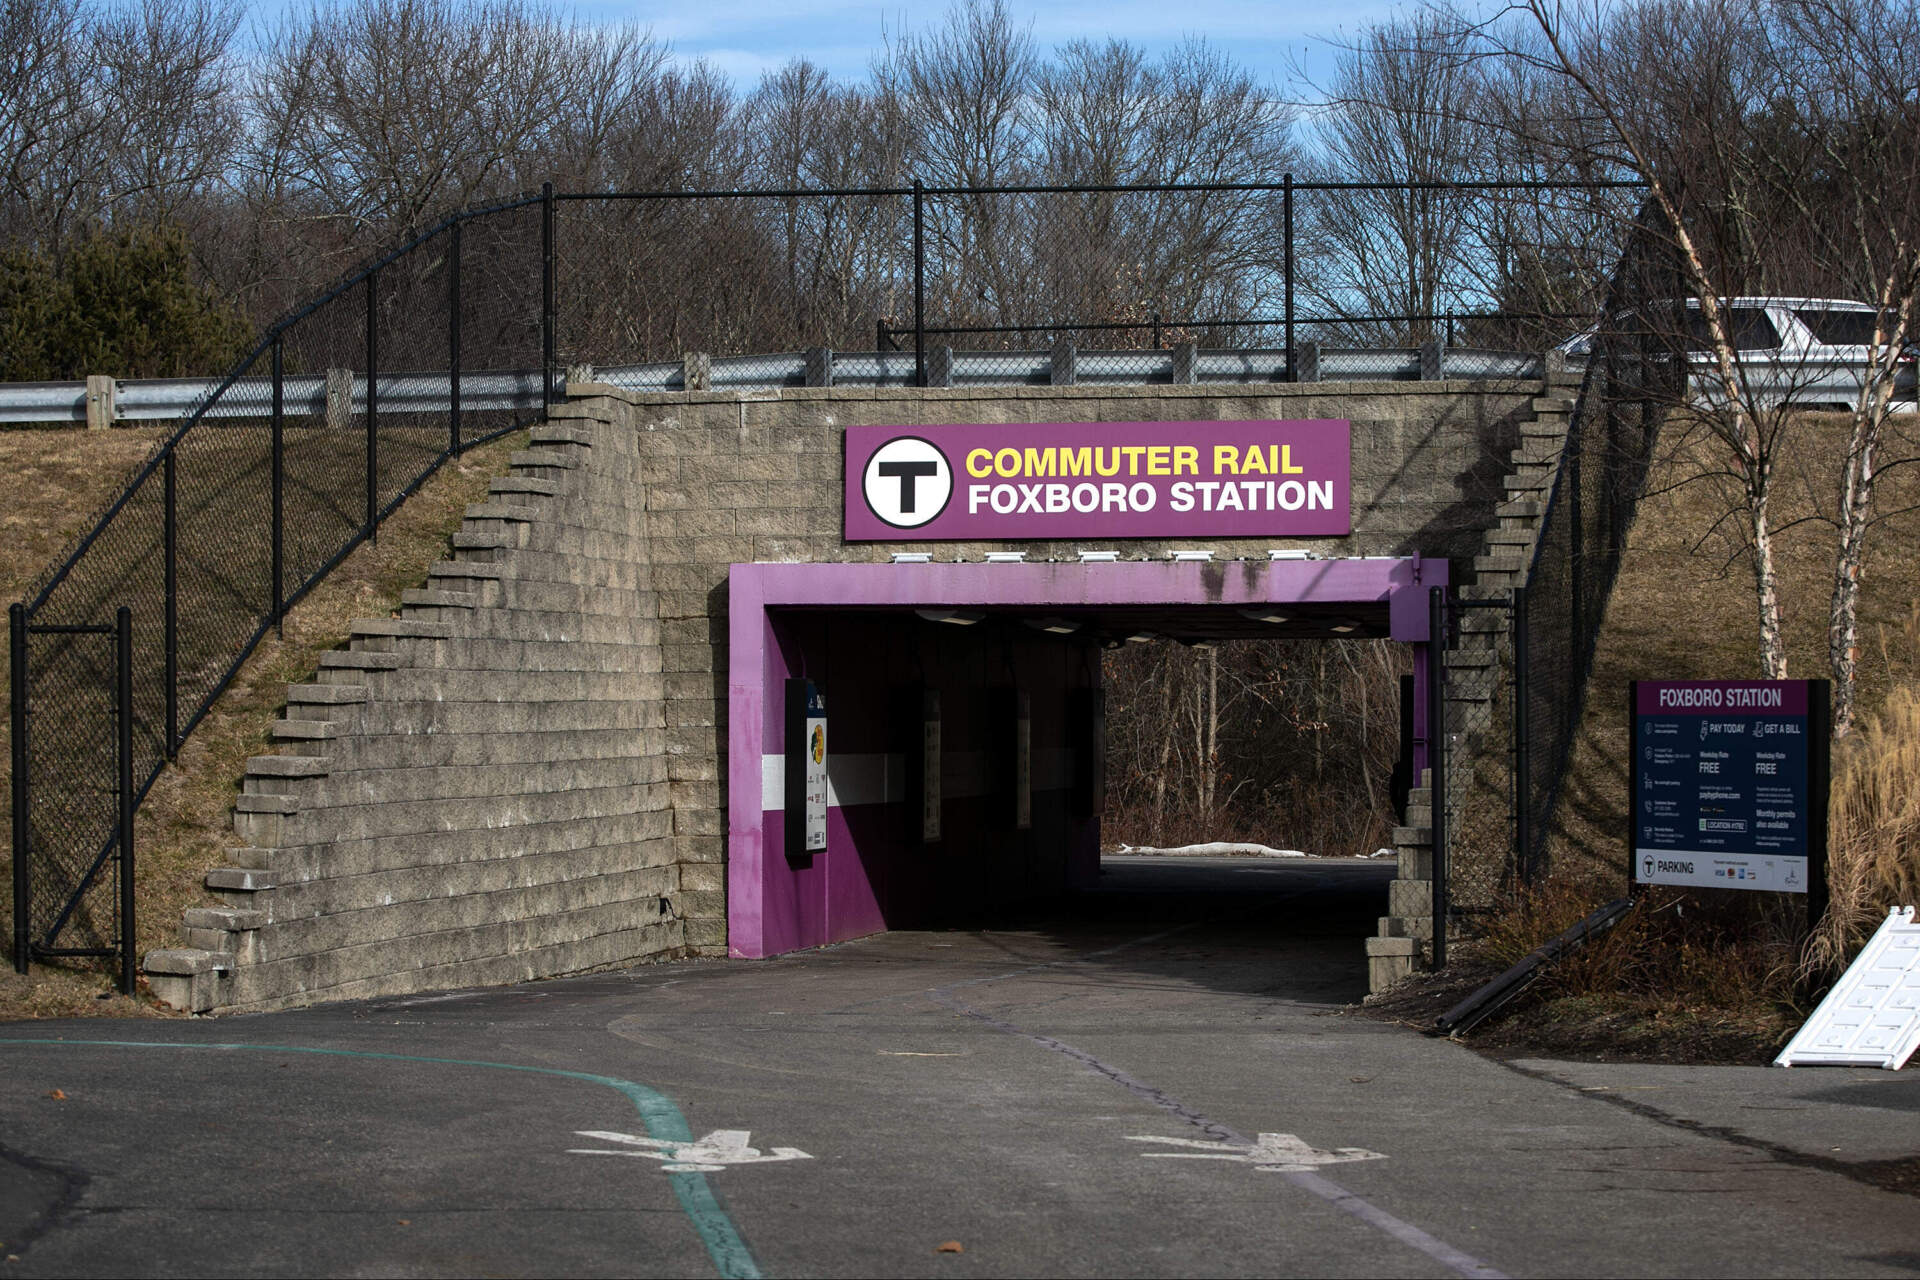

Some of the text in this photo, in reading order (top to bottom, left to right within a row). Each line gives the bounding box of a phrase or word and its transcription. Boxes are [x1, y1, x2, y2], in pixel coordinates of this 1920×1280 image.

[965, 445, 1304, 478] COMMUTER RAIL
[878, 461, 938, 514] T
[968, 480, 1334, 514] FOXBORO STATION
[1660, 688, 1782, 707] FOXBORO STATION
[1709, 724, 1745, 733] PAY TODAY
[1764, 724, 1801, 734] GET A BILL
[1699, 762, 1720, 773] FREE
[1755, 763, 1777, 774] FREE
[1756, 809, 1796, 819] Monthly permits
[1706, 821, 1731, 829] LOCATION
[1657, 860, 1694, 874] PARKING
